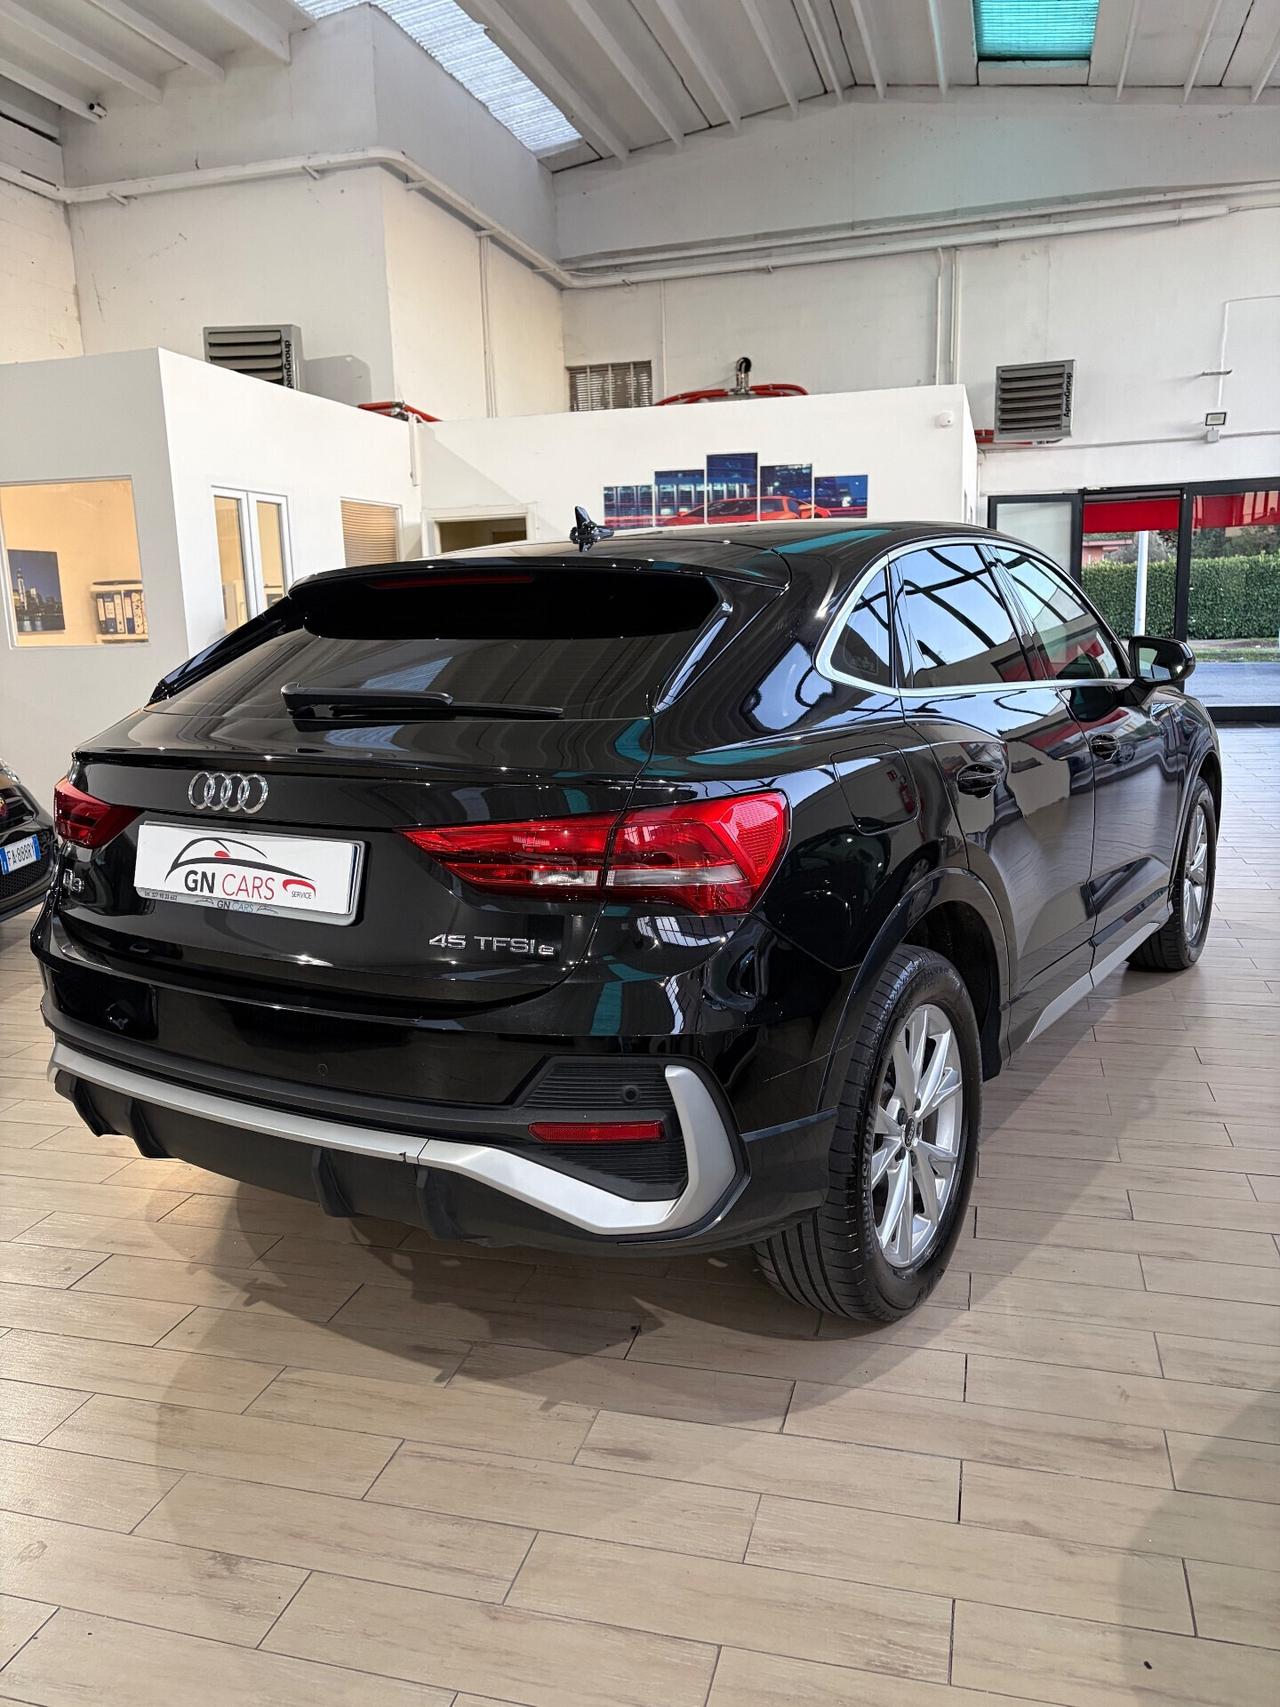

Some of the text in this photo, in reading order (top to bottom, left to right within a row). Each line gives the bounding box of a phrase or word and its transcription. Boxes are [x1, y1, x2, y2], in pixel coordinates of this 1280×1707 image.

[284, 340, 294, 389] penGroup
[1063, 372, 1073, 418] ApenGroup
[184, 869, 276, 900] GN CARS
[291, 890, 312, 900] SERVICE
[216, 901, 254, 912] GN CARS
[428, 933, 467, 949] 45
[474, 935, 536, 954] TFSI
